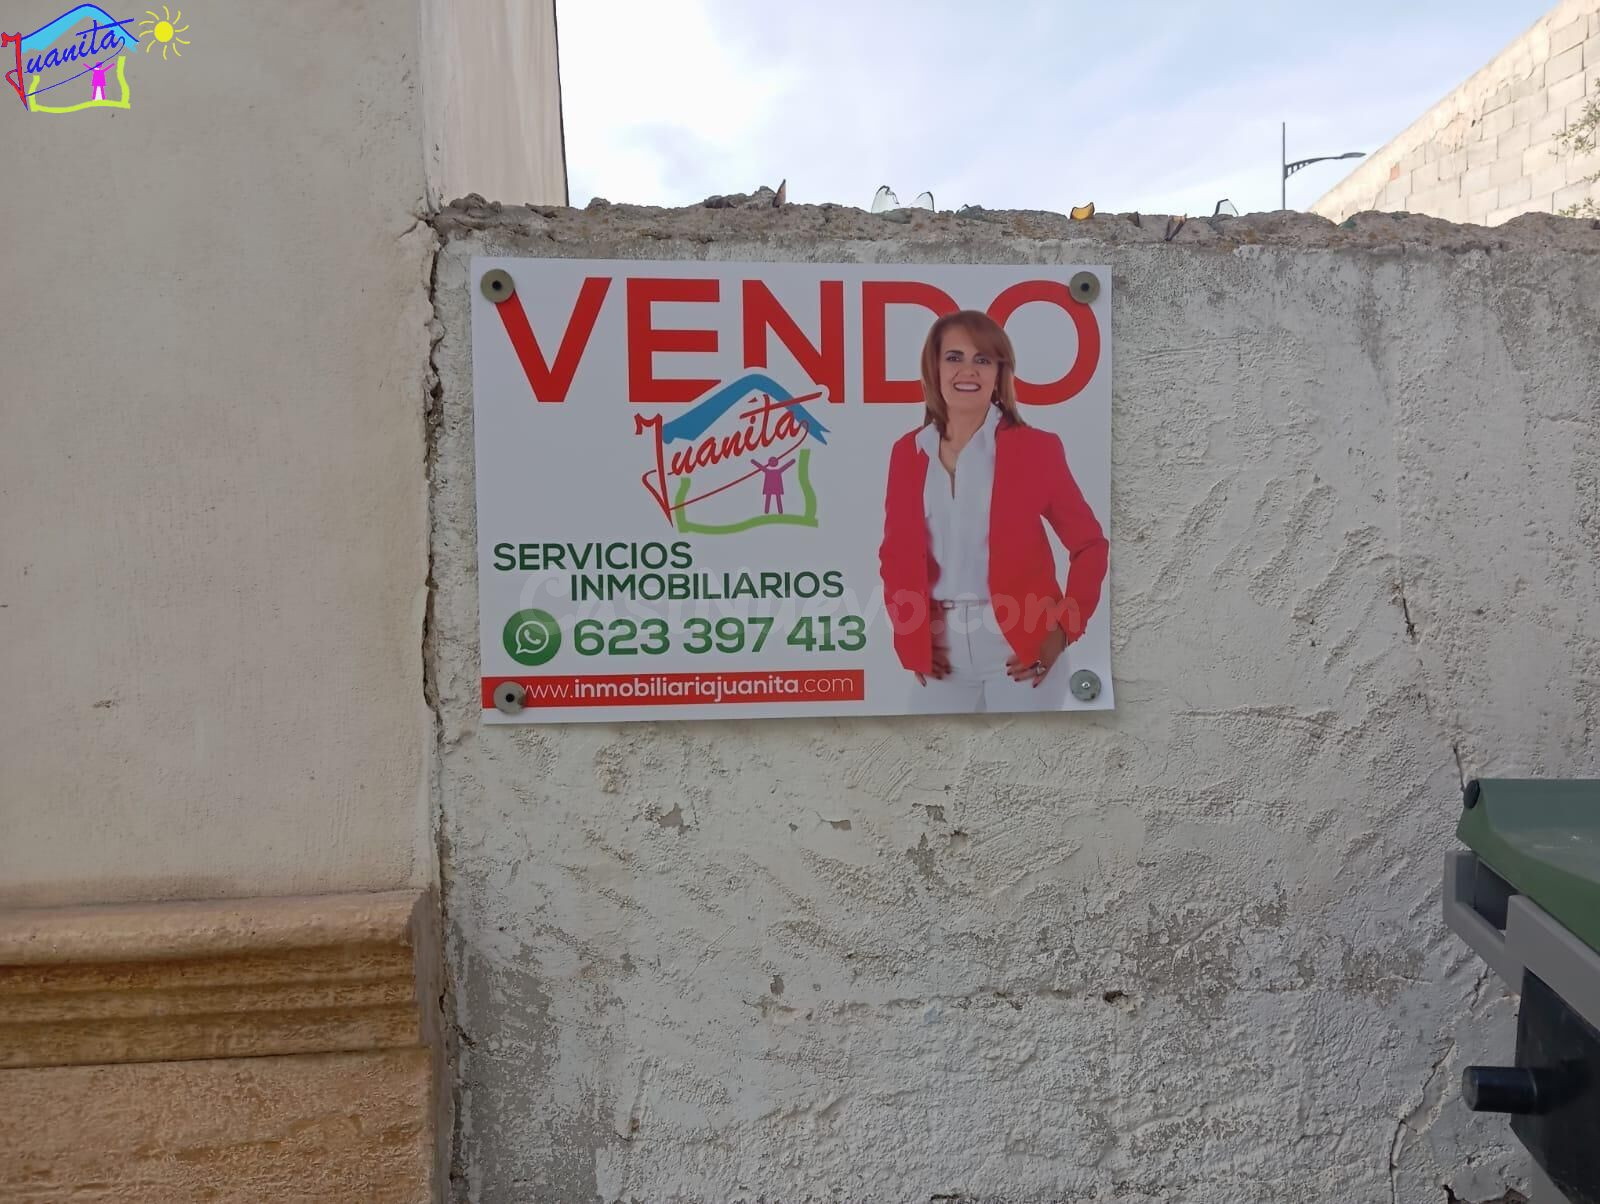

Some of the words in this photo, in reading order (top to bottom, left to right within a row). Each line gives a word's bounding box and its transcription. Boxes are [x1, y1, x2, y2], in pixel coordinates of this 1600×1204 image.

[495, 276, 1100, 404] VENDO
[634, 391, 823, 527] Juanita
[493, 542, 693, 571] SERVICIOS
[571, 571, 844, 600] INMOBILIARIOS
[574, 618, 670, 656] 623
[683, 617, 774, 654] 397
[787, 615, 867, 652] 413
[523, 675, 854, 702] ww.inmobiliariajuanita.com
